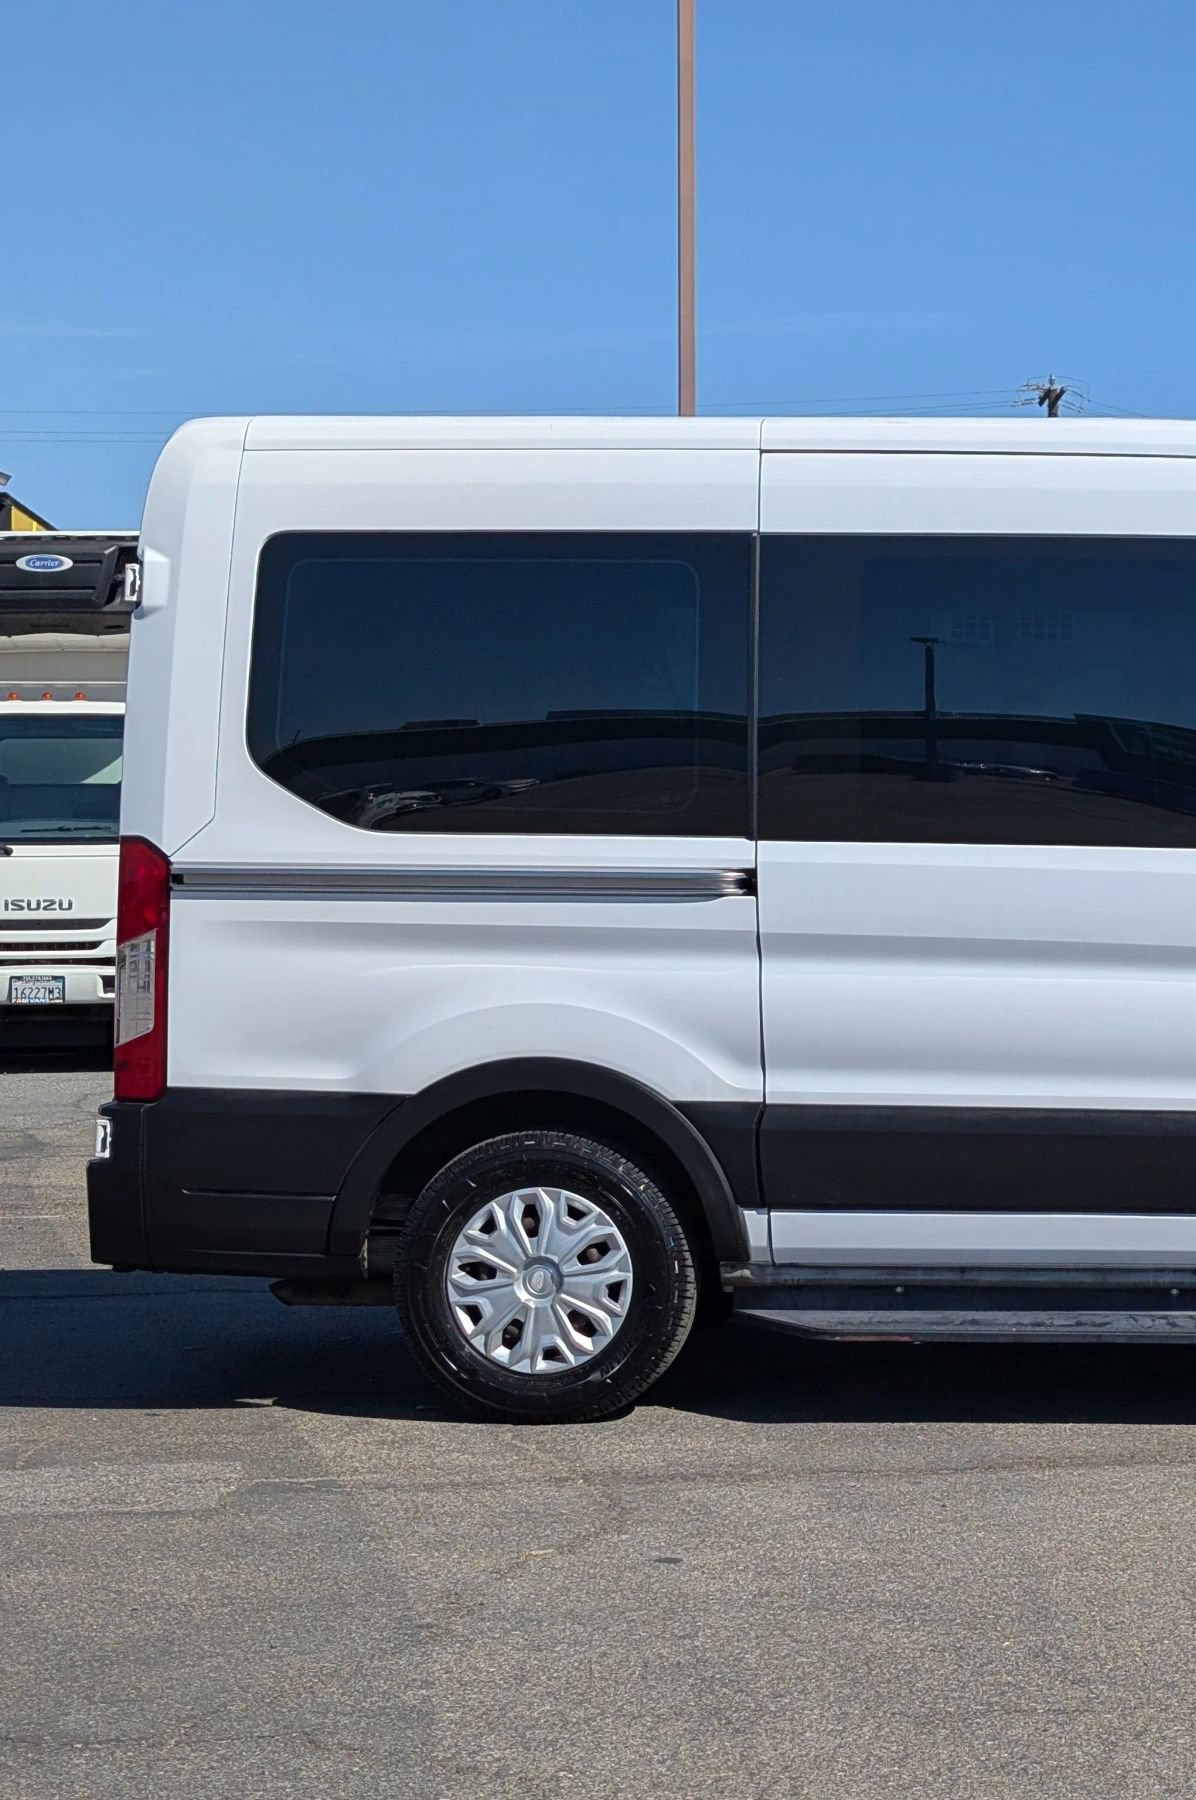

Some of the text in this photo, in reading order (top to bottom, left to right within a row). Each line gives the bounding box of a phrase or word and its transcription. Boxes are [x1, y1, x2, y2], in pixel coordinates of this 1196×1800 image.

[29, 559, 60, 567] Carrier
[4, 899, 73, 911] ISUZU
[14, 986, 62, 999] 16227M3
